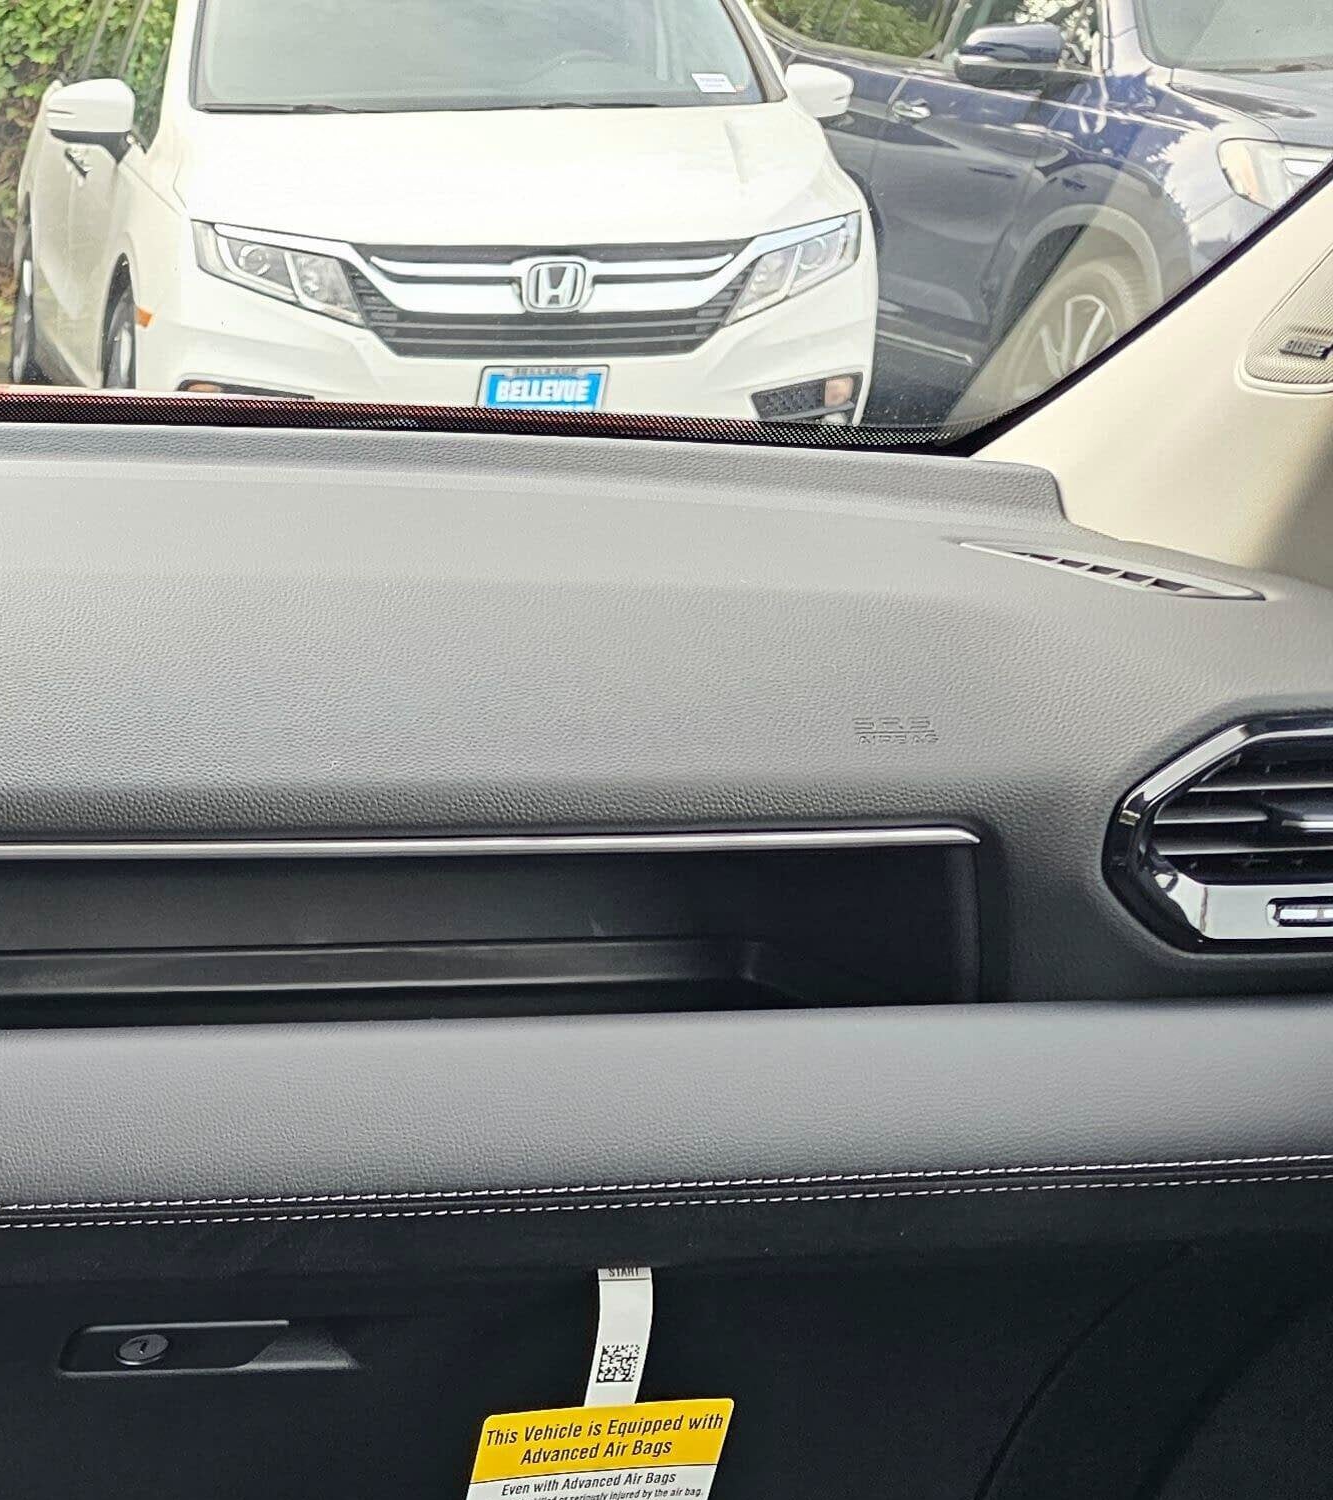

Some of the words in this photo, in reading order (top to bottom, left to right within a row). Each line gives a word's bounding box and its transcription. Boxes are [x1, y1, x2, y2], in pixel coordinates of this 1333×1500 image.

[495, 379, 592, 402] BELLEVUE
[486, 1430, 518, 1446] This
[524, 1423, 582, 1442] Vehicle
[588, 1421, 602, 1436] is
[607, 1415, 684, 1437] Equipped
[688, 1414, 723, 1430] with
[520, 1444, 599, 1465] Advanced
[604, 1442, 628, 1457] Air
[632, 1440, 672, 1459] Bags
[501, 1484, 530, 1496] Even
[533, 1479, 559, 1492] with
[561, 1474, 621, 1491] Advanced
[624, 1473, 643, 1485] Air
[645, 1472, 676, 1485] Bags
[609, 1490, 640, 1500] injured
[642, 1489, 652, 1499] by
[654, 1488, 668, 1497] the
[670, 1488, 683, 1497] air
[685, 1487, 703, 1498] bag.
